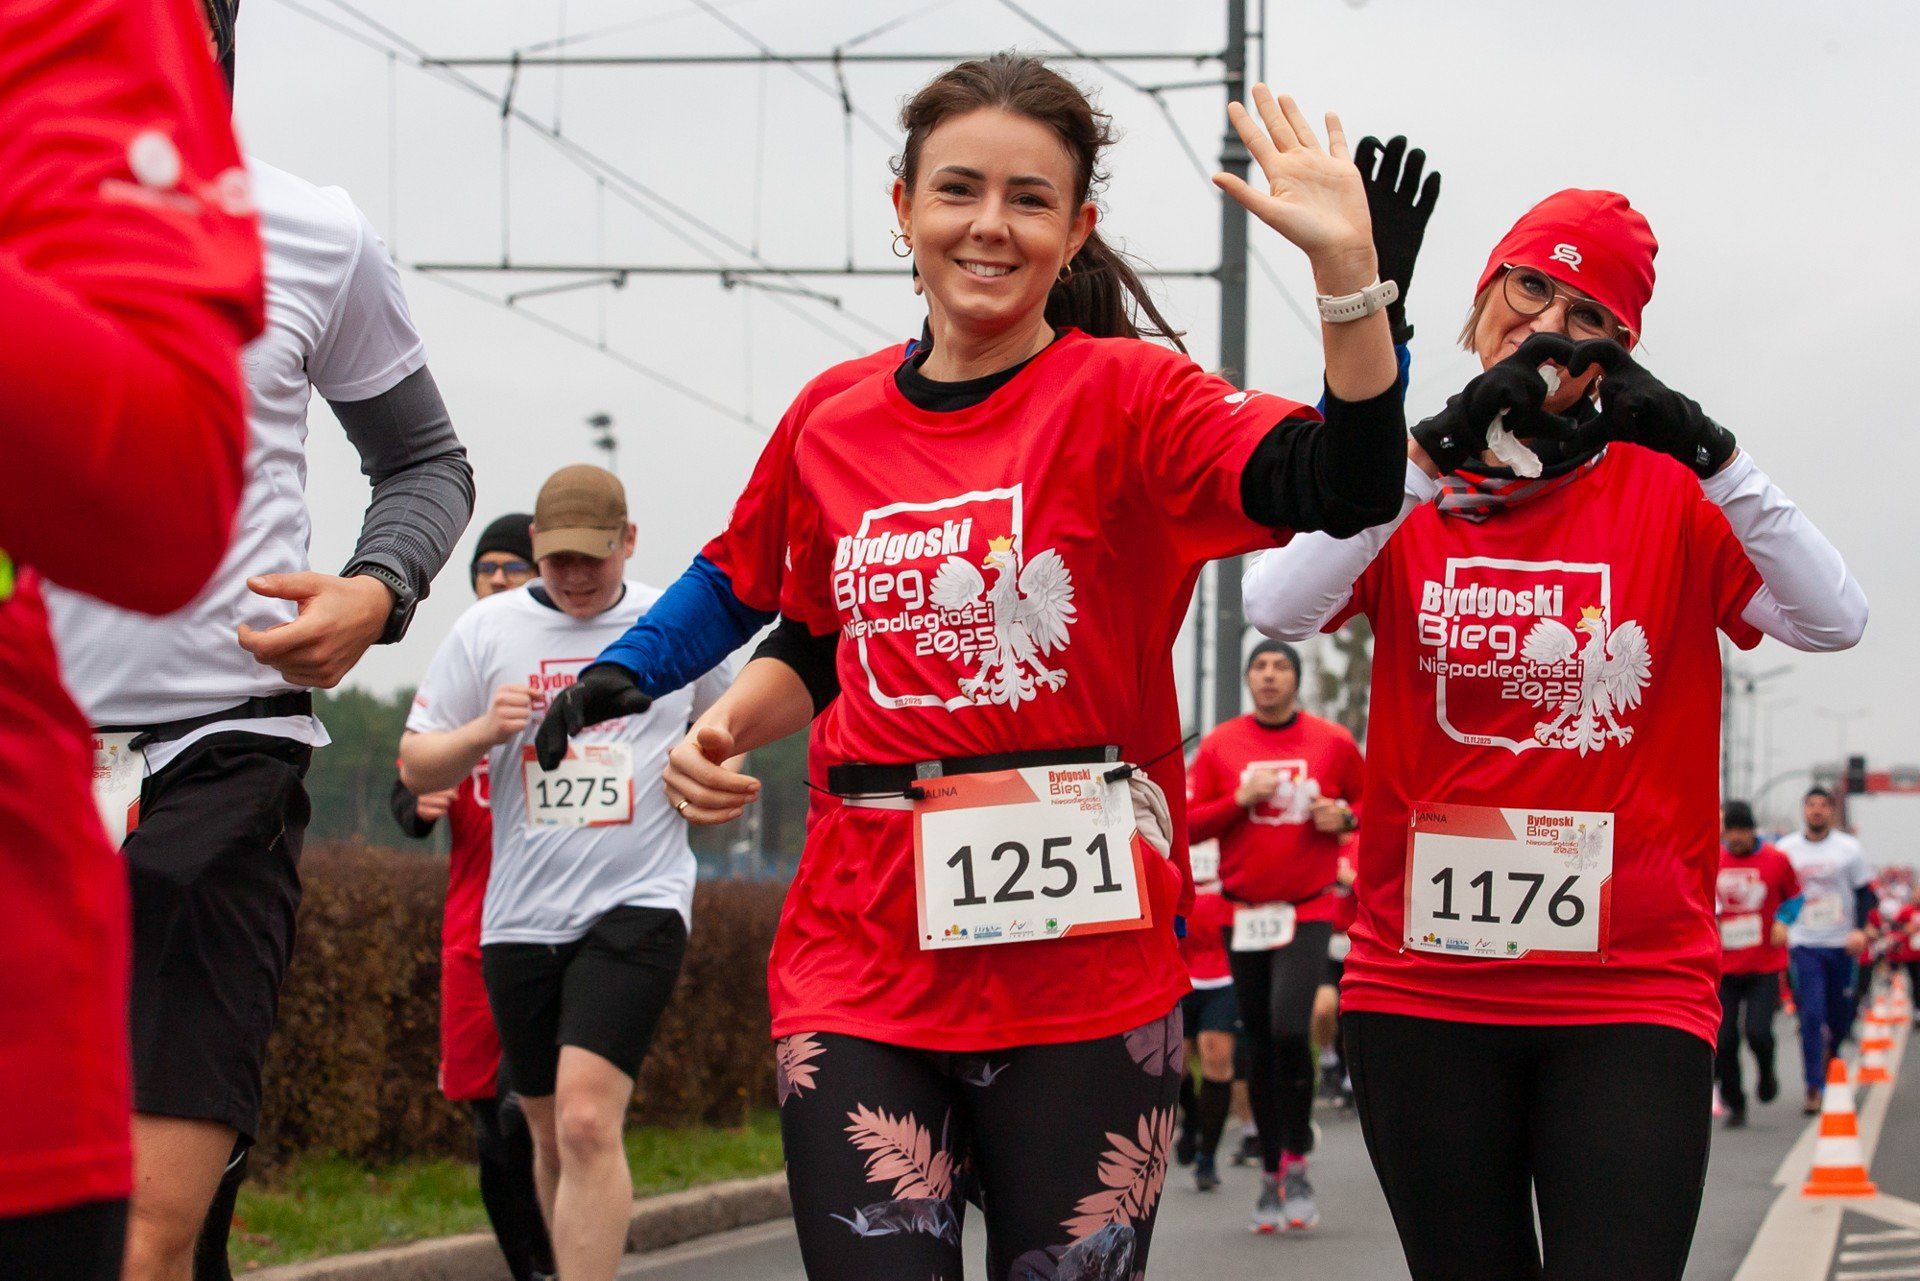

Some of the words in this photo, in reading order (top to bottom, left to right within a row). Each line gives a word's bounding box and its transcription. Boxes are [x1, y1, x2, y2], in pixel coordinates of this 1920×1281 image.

[834, 518, 972, 572] Bydgoski
[833, 566, 924, 611] Bieg
[1420, 580, 1563, 618] Bydgoski
[843, 601, 995, 642] Niepodległości
[1418, 612, 1517, 660] Bieg
[915, 626, 997, 656] 2025
[1419, 655, 1584, 682] Niepodległości
[1501, 681, 1583, 701] 2025
[1048, 769, 1091, 784] Bydgoski
[1050, 782, 1082, 797] Bieg
[536, 777, 619, 809] 1275
[1526, 826, 1559, 841] Bieg
[1527, 814, 1574, 828] Bydgoski
[947, 833, 1122, 907] 1251
[1431, 867, 1585, 927] 1176
